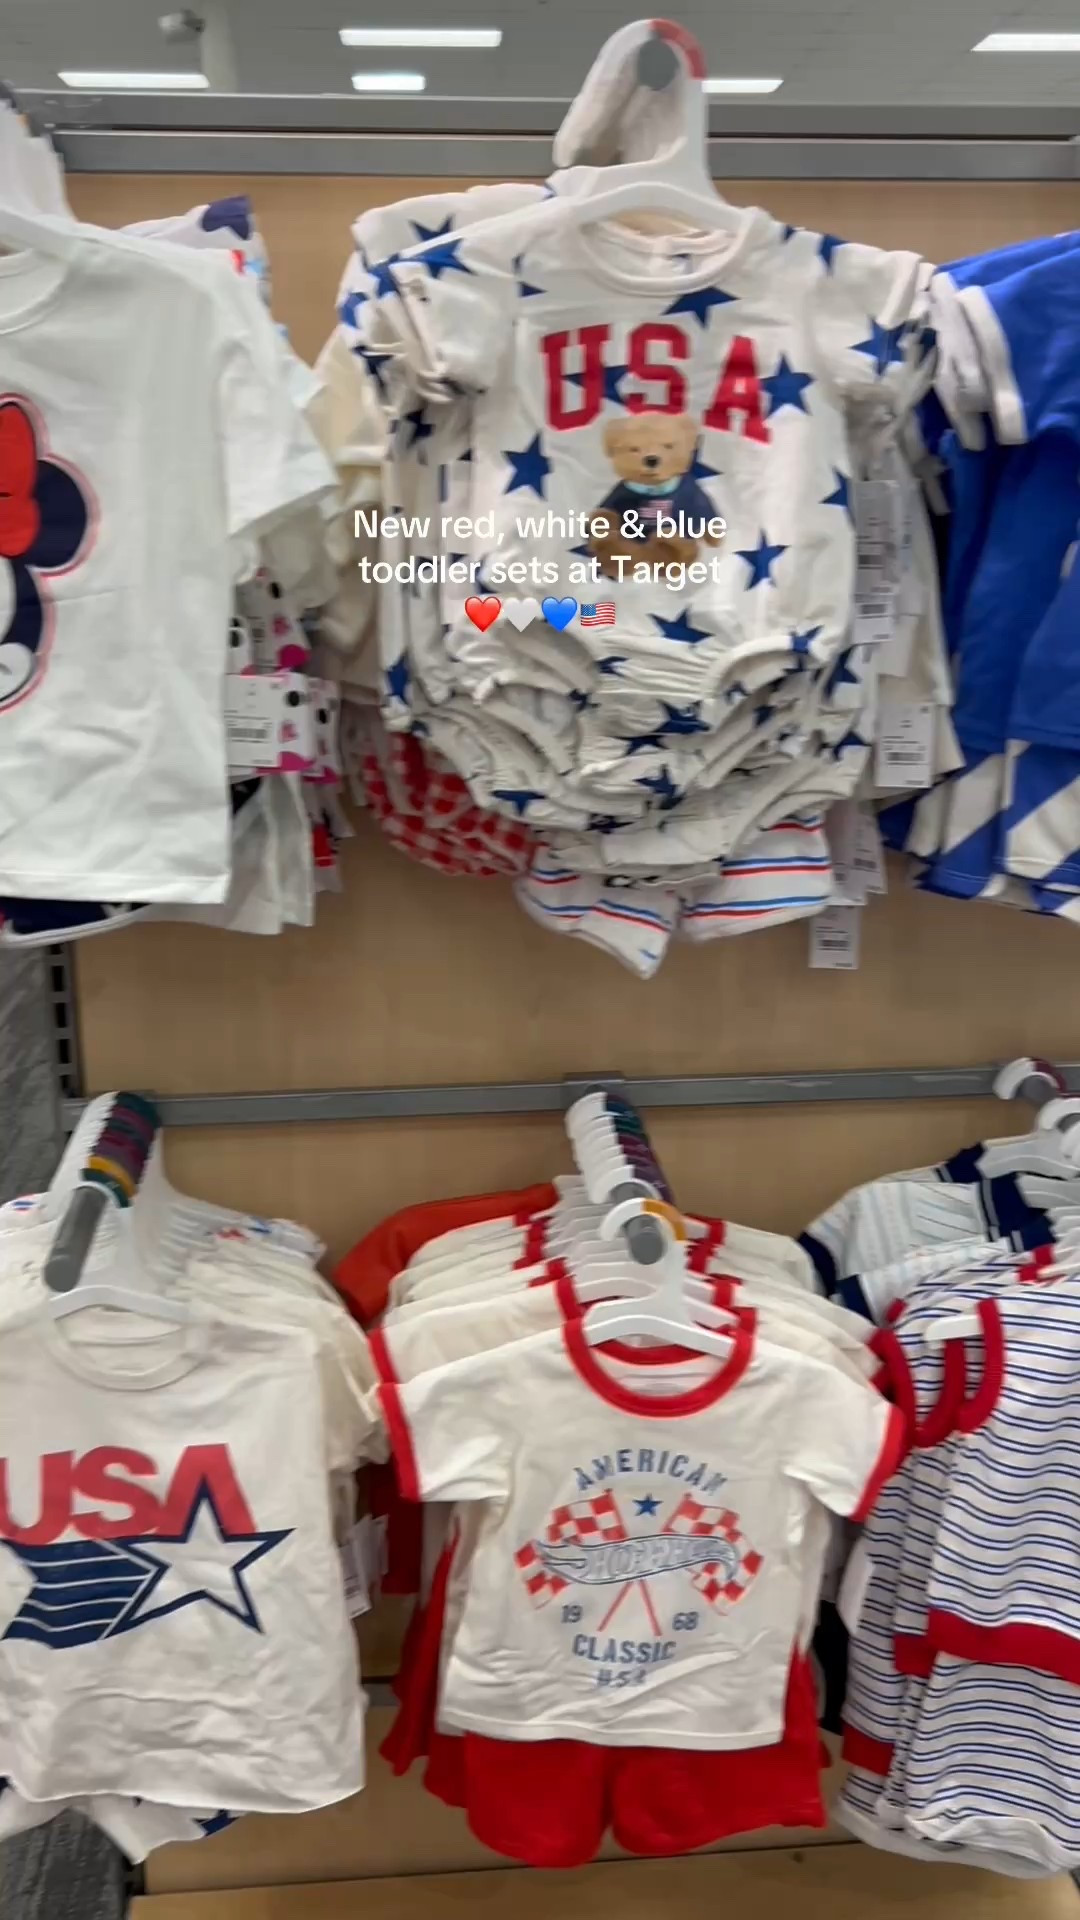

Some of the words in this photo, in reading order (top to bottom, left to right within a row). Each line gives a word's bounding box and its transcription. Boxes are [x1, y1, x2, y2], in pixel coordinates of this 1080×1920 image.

[541, 322, 771, 444] USA
[0, 1443, 258, 1545] USA
[573, 1448, 728, 1496] AMERICAN
[561, 1604, 584, 1623] 19
[672, 1611, 699, 1631] 68
[571, 1633, 677, 1664] CLASSIC
